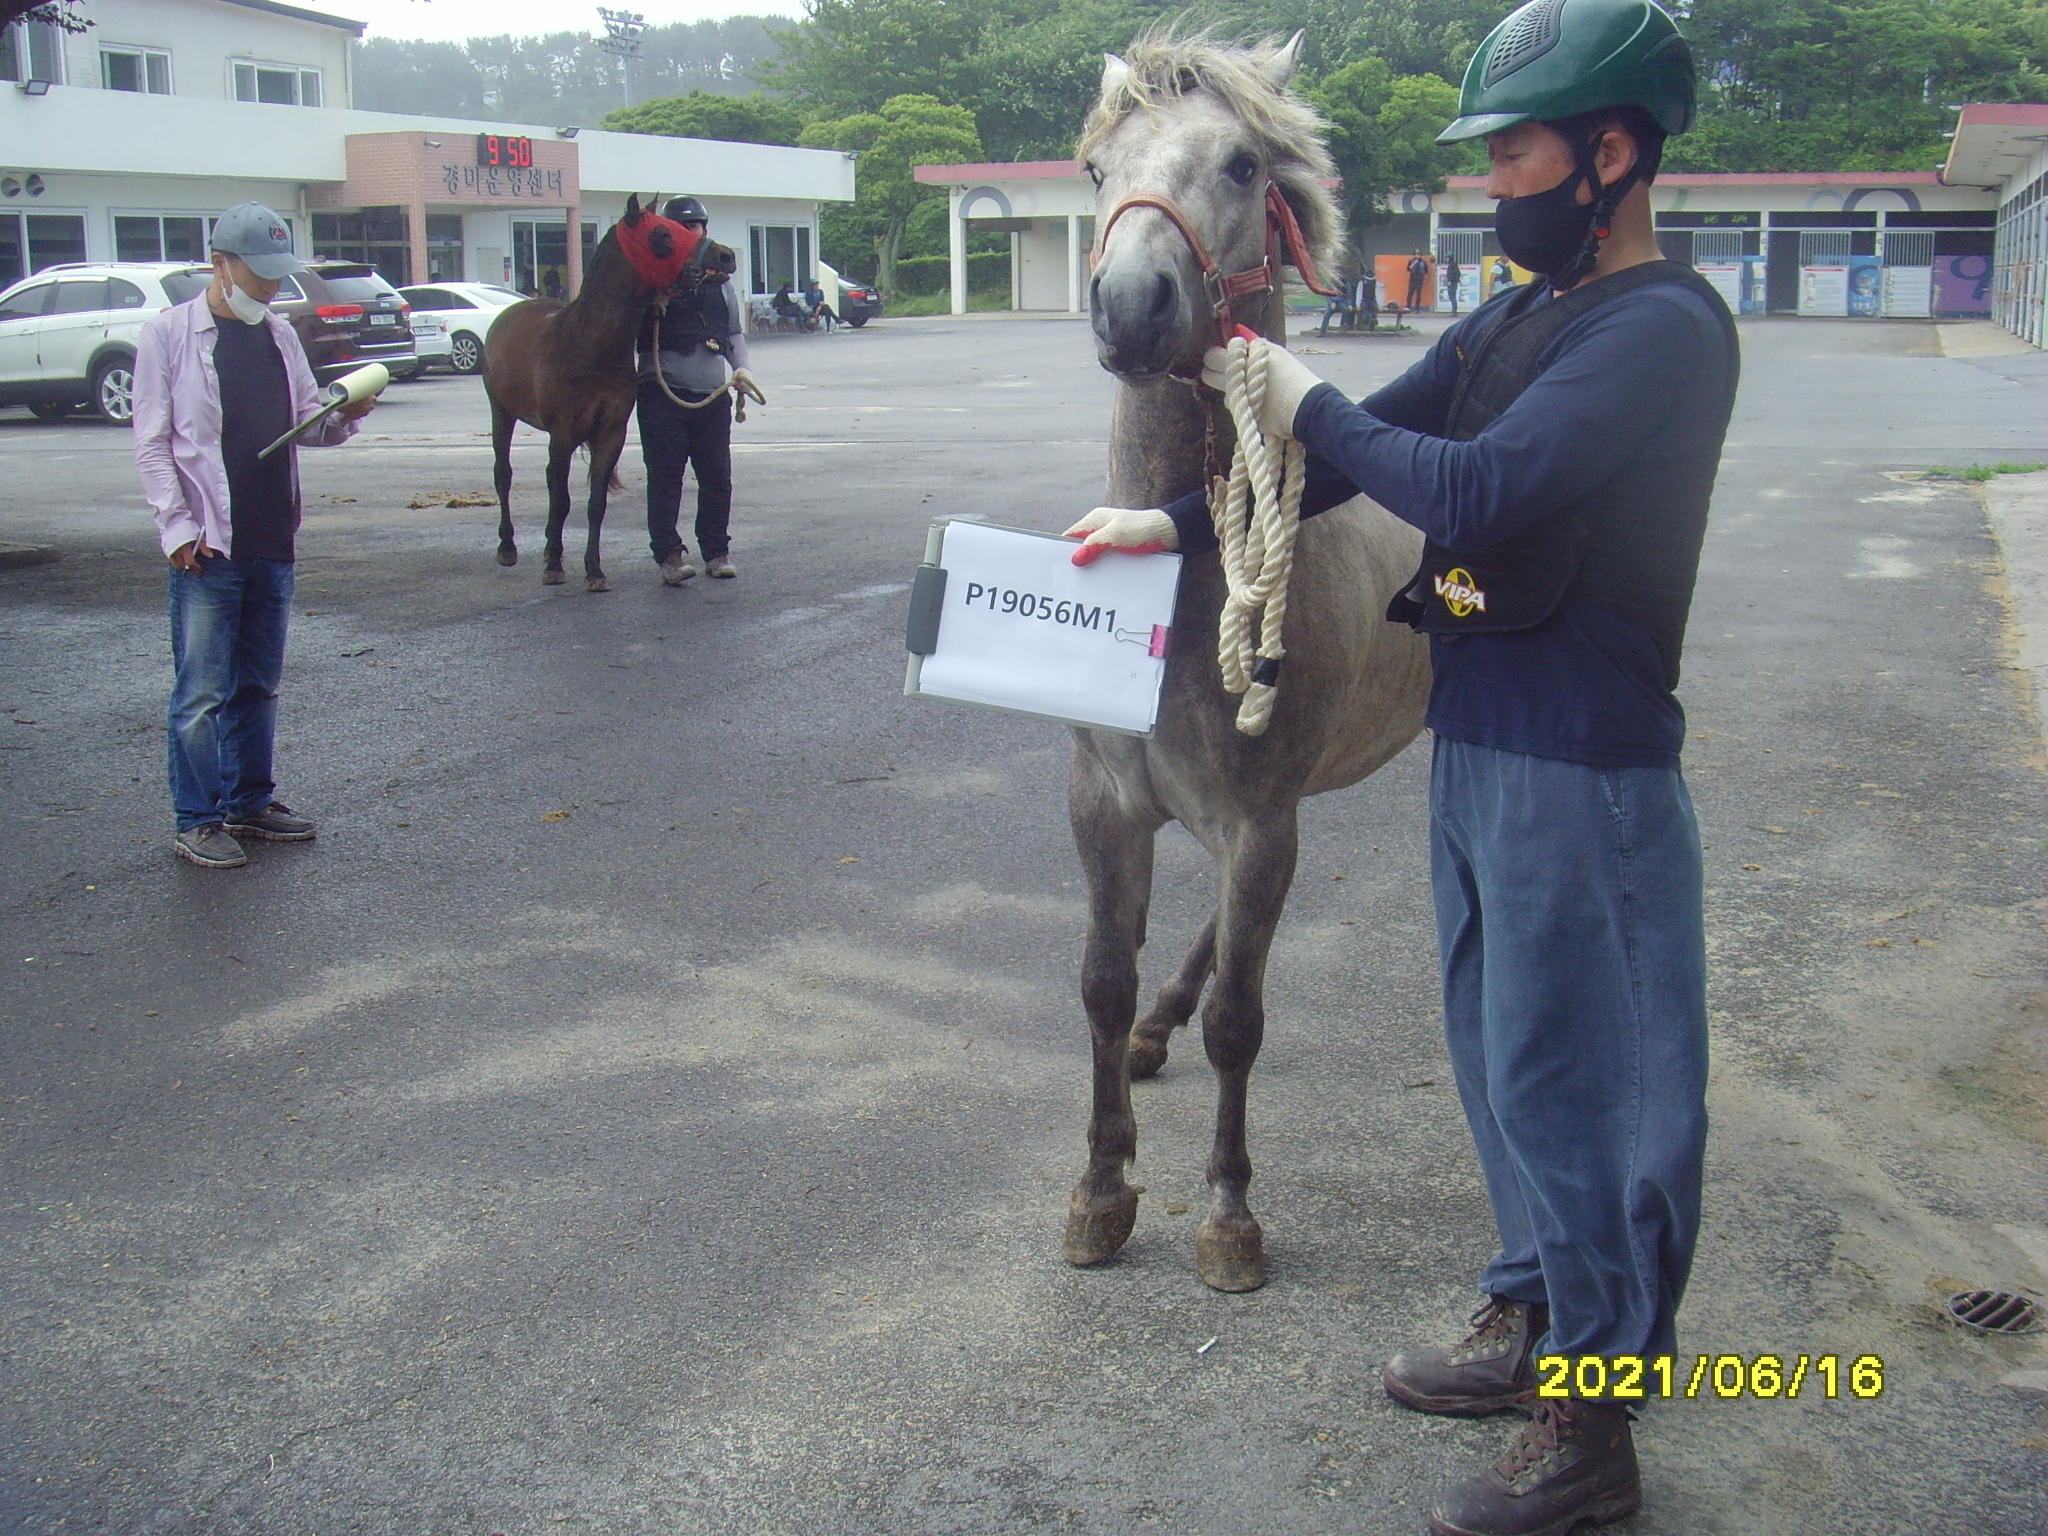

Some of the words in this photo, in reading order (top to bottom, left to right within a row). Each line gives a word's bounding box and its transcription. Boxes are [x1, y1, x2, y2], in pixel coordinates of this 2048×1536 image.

[487, 136, 499, 165] 9
[507, 138, 530, 166] 50
[965, 582, 1117, 633] P19056M1
[1434, 575, 1486, 612] VIPA
